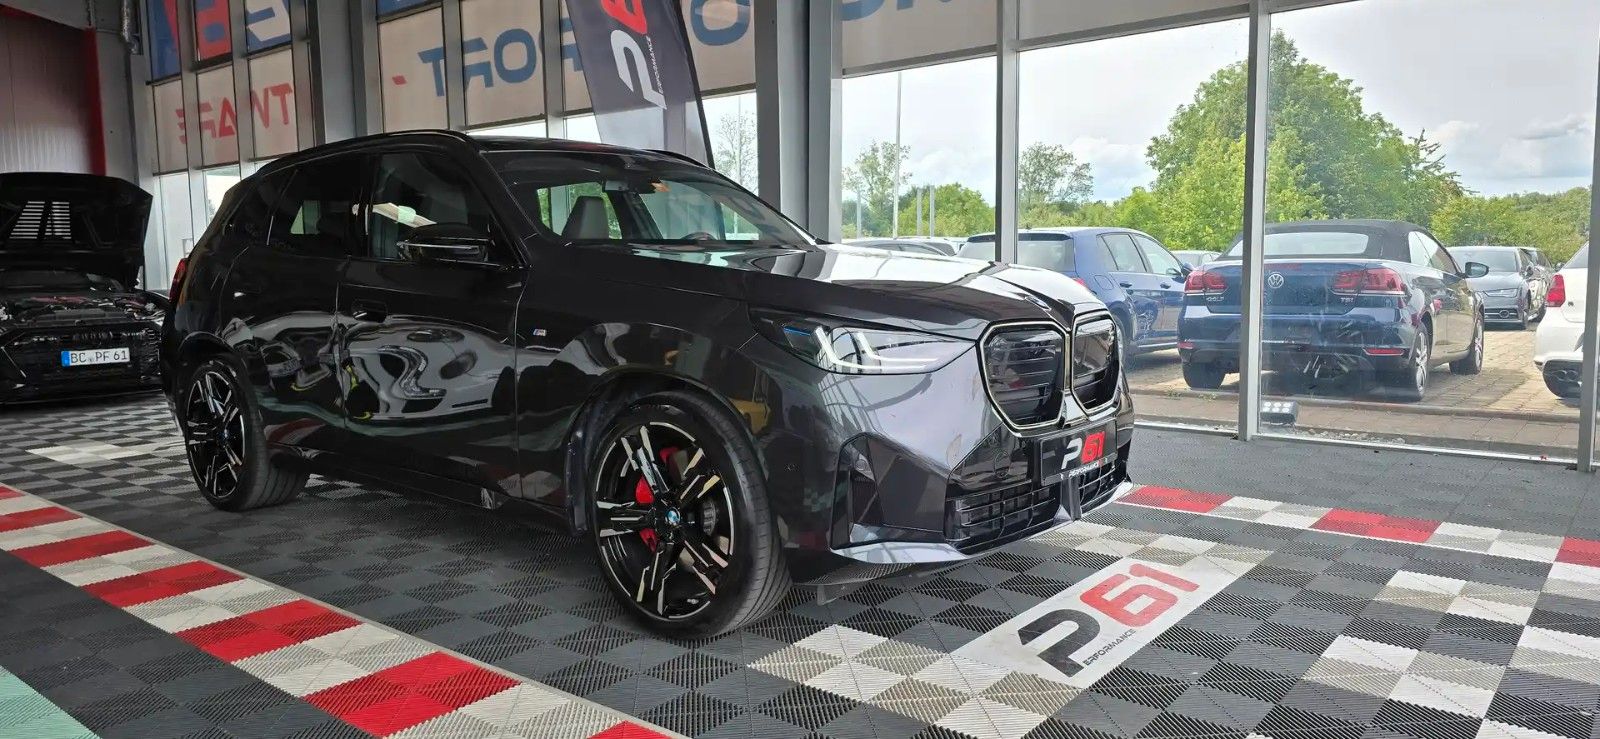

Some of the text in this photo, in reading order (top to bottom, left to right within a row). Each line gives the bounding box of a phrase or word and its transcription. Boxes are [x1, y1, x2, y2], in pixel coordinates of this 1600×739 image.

[70, 350, 128, 363] BC PF 61
[1061, 431, 1106, 470] P61
[1017, 563, 1200, 678] P61
